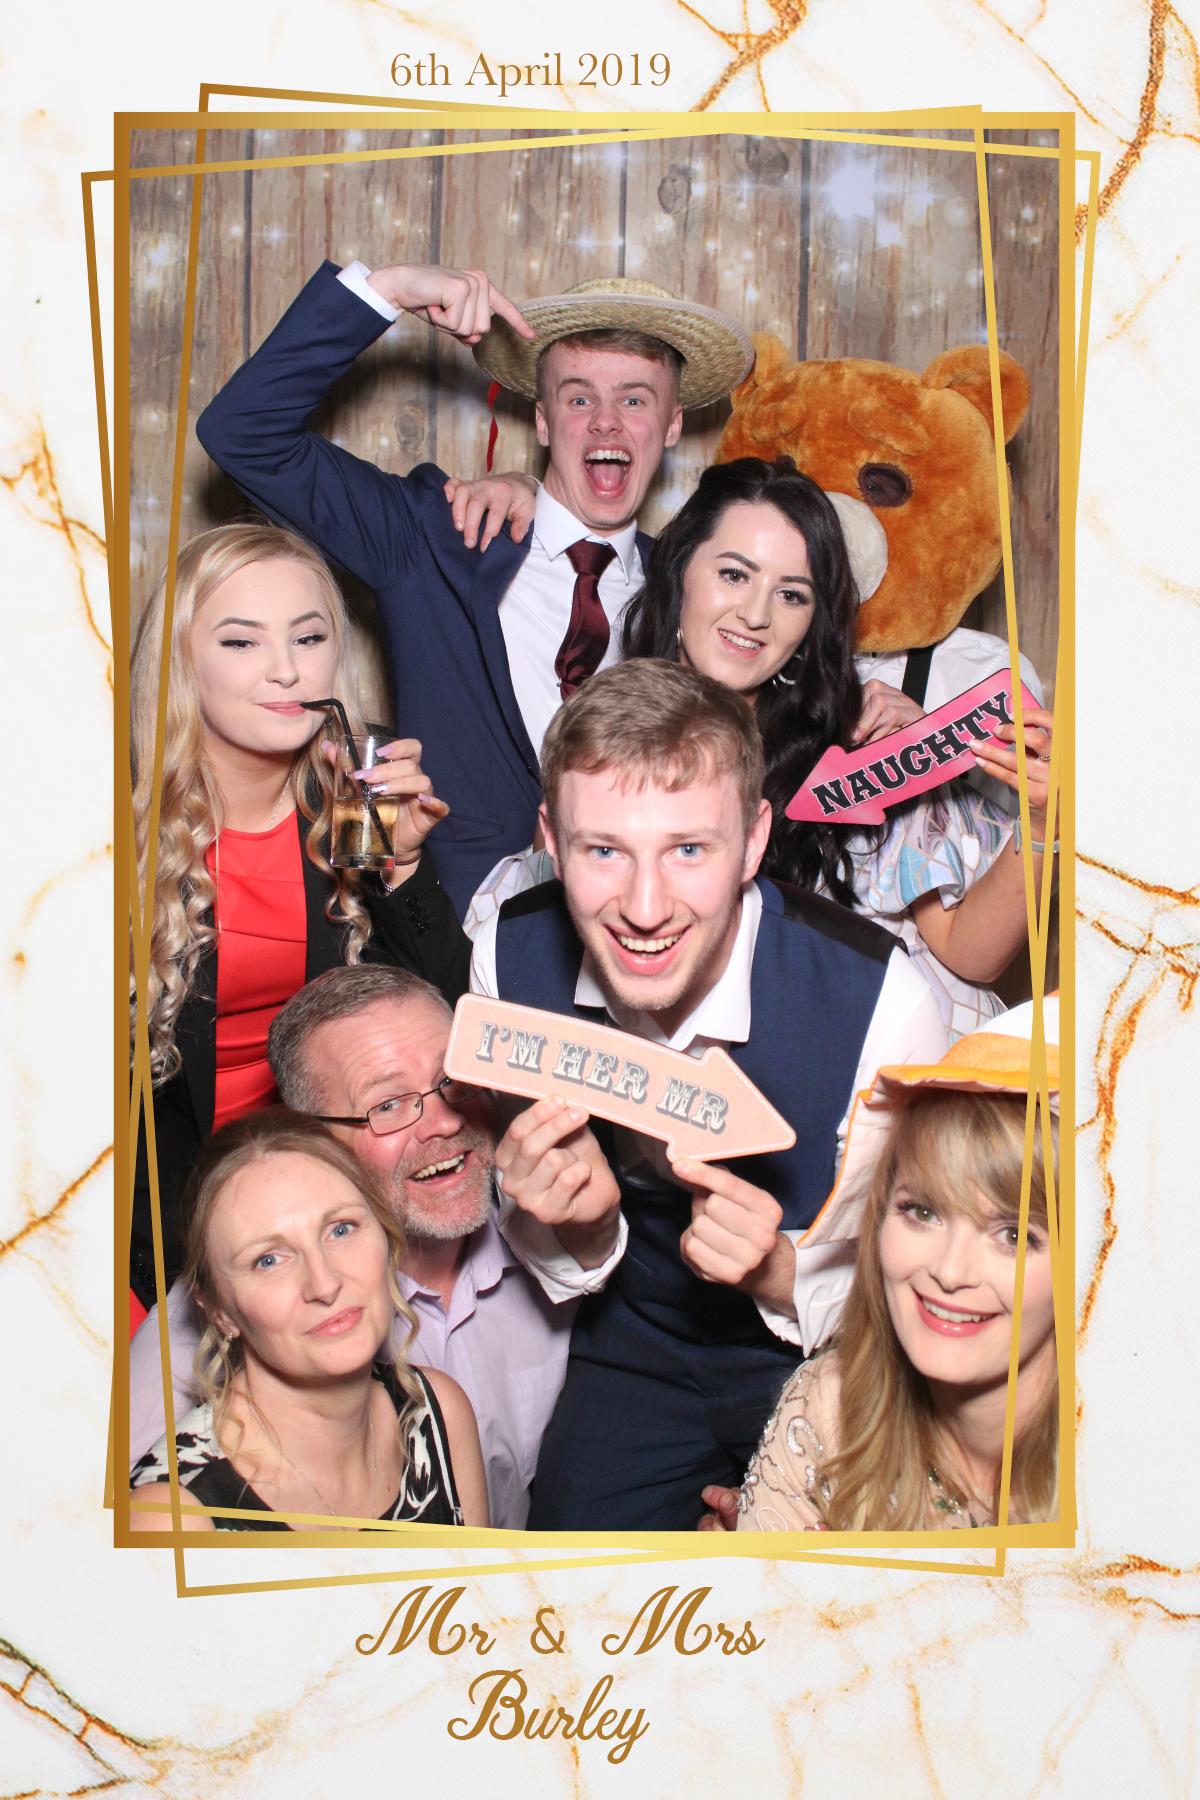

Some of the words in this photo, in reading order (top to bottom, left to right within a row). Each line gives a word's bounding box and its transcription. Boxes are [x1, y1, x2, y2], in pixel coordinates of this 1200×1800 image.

[811, 690, 1015, 816] NAUGHTY
[552, 1040, 650, 1103] HER
[656, 1075, 730, 1135] MR
